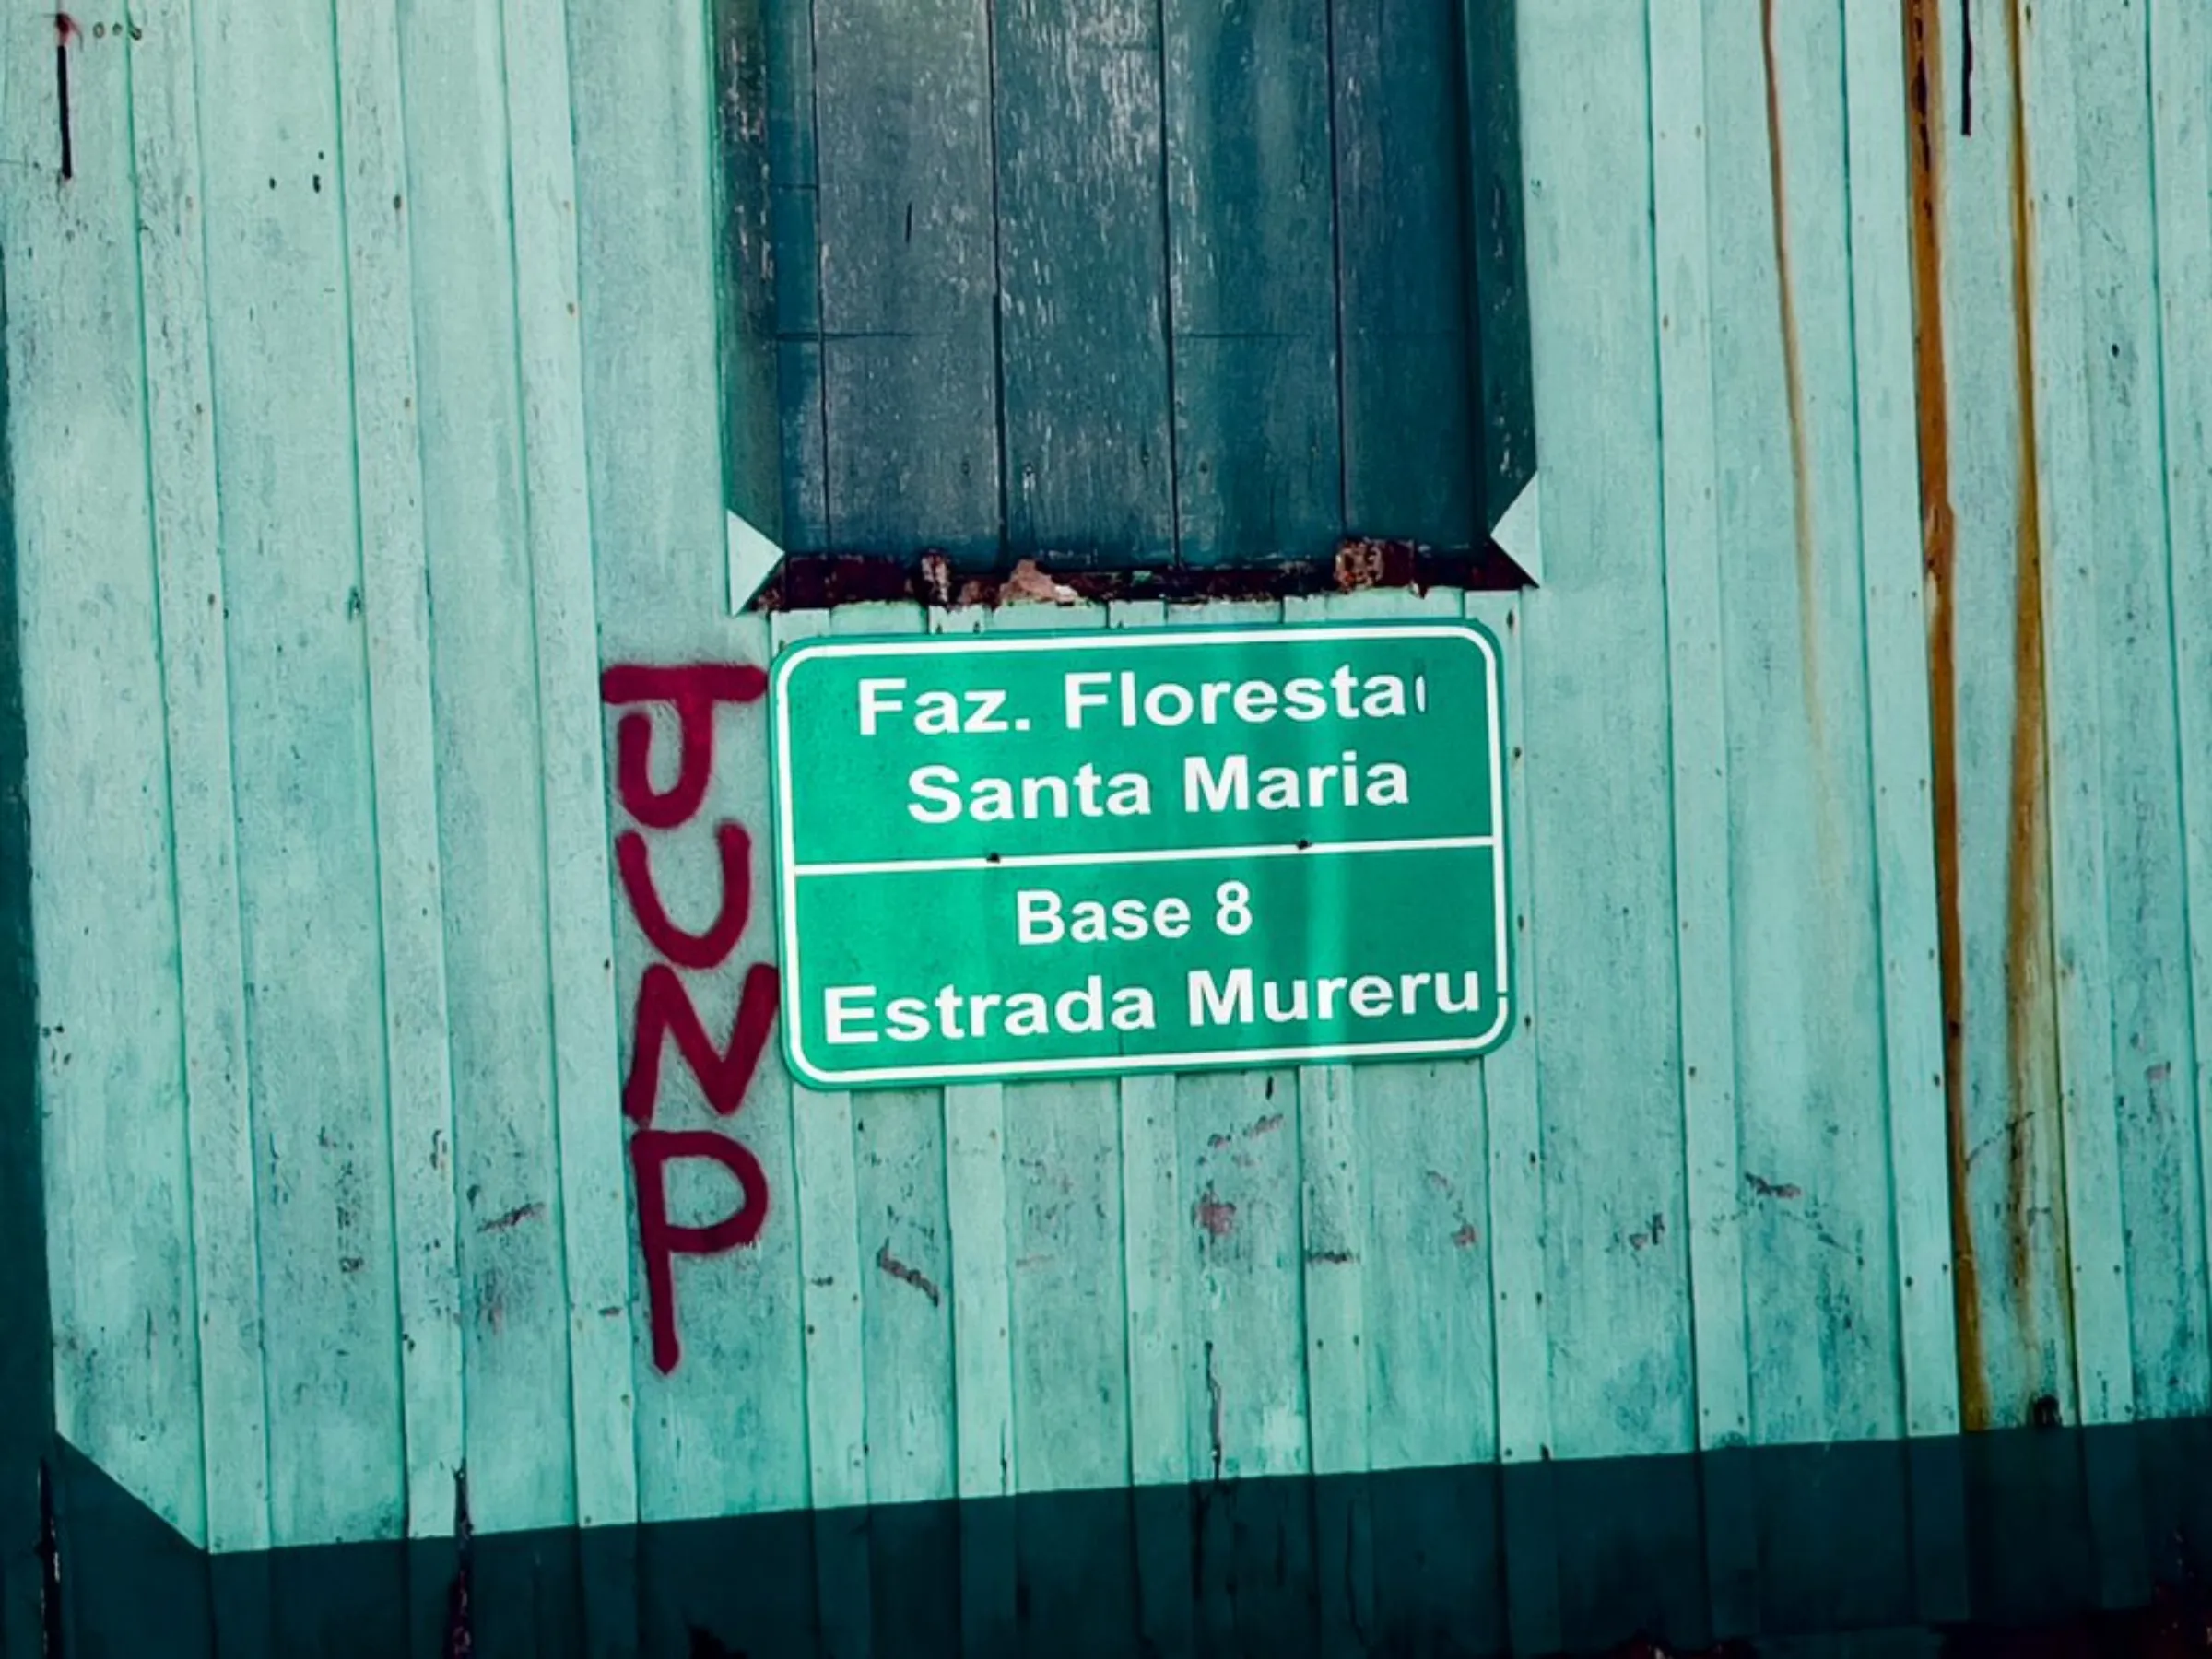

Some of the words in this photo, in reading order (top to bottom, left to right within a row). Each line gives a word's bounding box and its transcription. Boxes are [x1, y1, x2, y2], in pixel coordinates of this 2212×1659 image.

[858, 677, 1030, 736] Faz.
[908, 762, 1152, 824] Santa
[1183, 750, 1410, 813] Maria
[1017, 889, 1191, 946] Base
[1215, 880, 1253, 936] 8
[824, 974, 1156, 1045] Estrada
[1188, 967, 1479, 1027] Mureru
